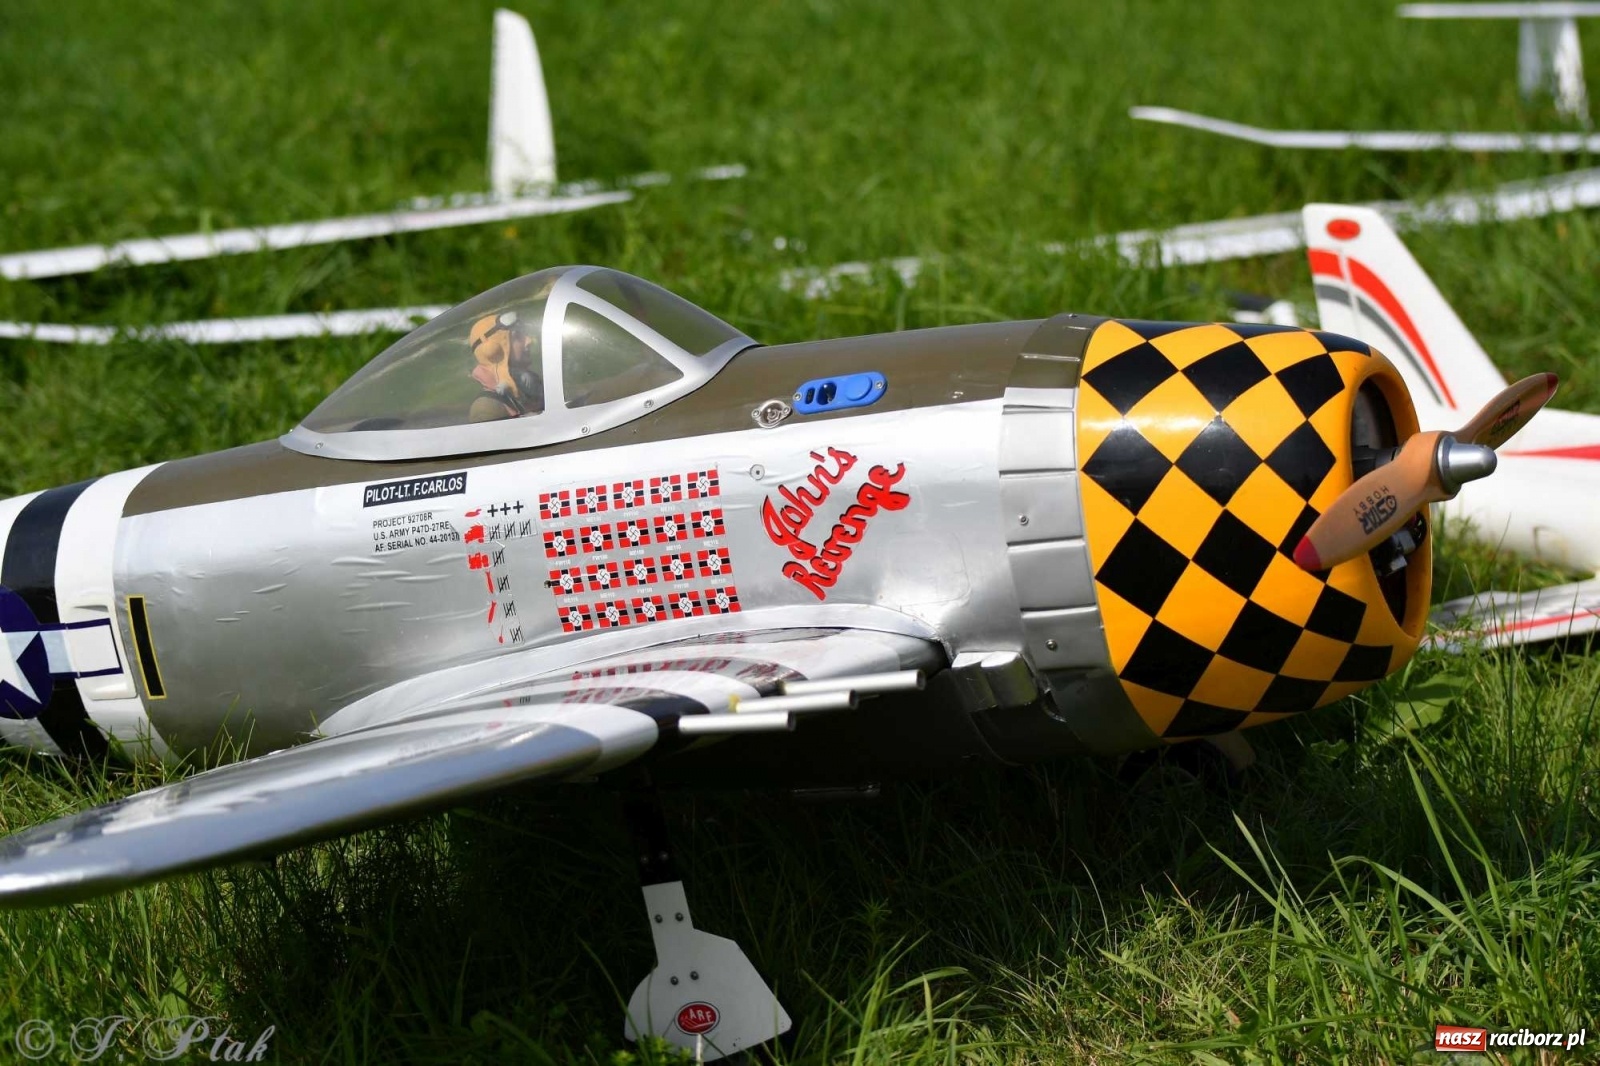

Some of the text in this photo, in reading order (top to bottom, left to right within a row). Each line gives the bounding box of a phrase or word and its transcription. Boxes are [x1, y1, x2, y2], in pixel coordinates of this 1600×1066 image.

[366, 477, 463, 503] PILOT-LT. F.CARLOS
[1353, 485, 1391, 518] HOBBY
[373, 516, 406, 528] PROJECT
[373, 521, 450, 541] U.S. ARMY P47D-27RE
[387, 540, 414, 552] SERIAL
[414, 537, 429, 547] NO.
